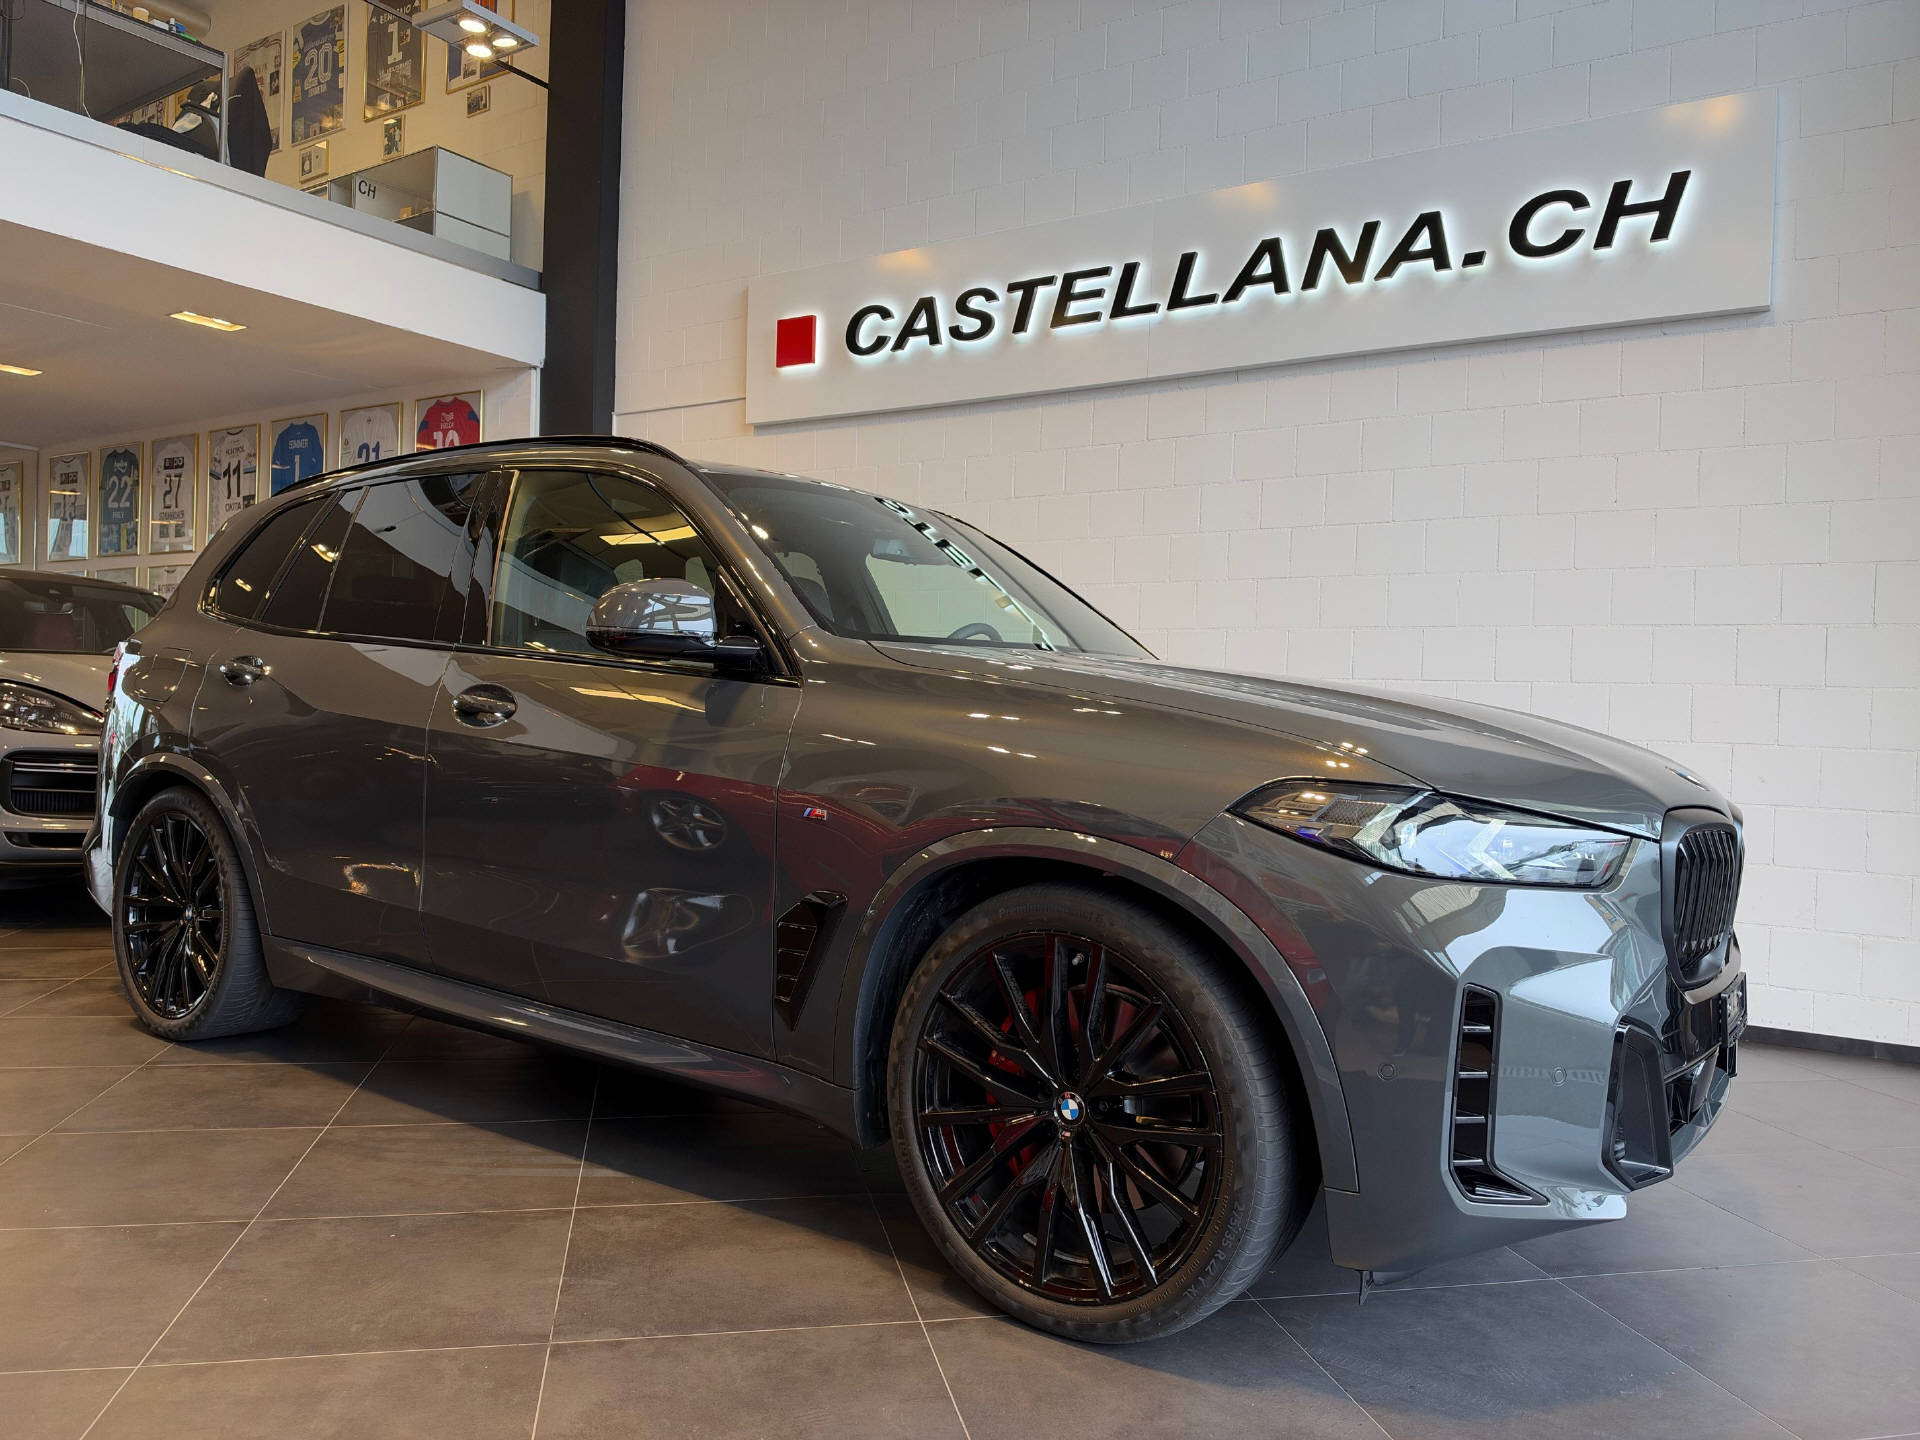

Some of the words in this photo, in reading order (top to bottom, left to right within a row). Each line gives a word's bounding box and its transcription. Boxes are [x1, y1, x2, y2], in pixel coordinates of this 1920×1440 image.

[388, 21, 402, 65] 1
[304, 42, 332, 90] 20
[359, 180, 376, 199] CH
[845, 170, 1692, 357] CASTELLANA.CH
[108, 475, 132, 508] 22
[163, 472, 183, 509] 27
[223, 459, 240, 499] 11
